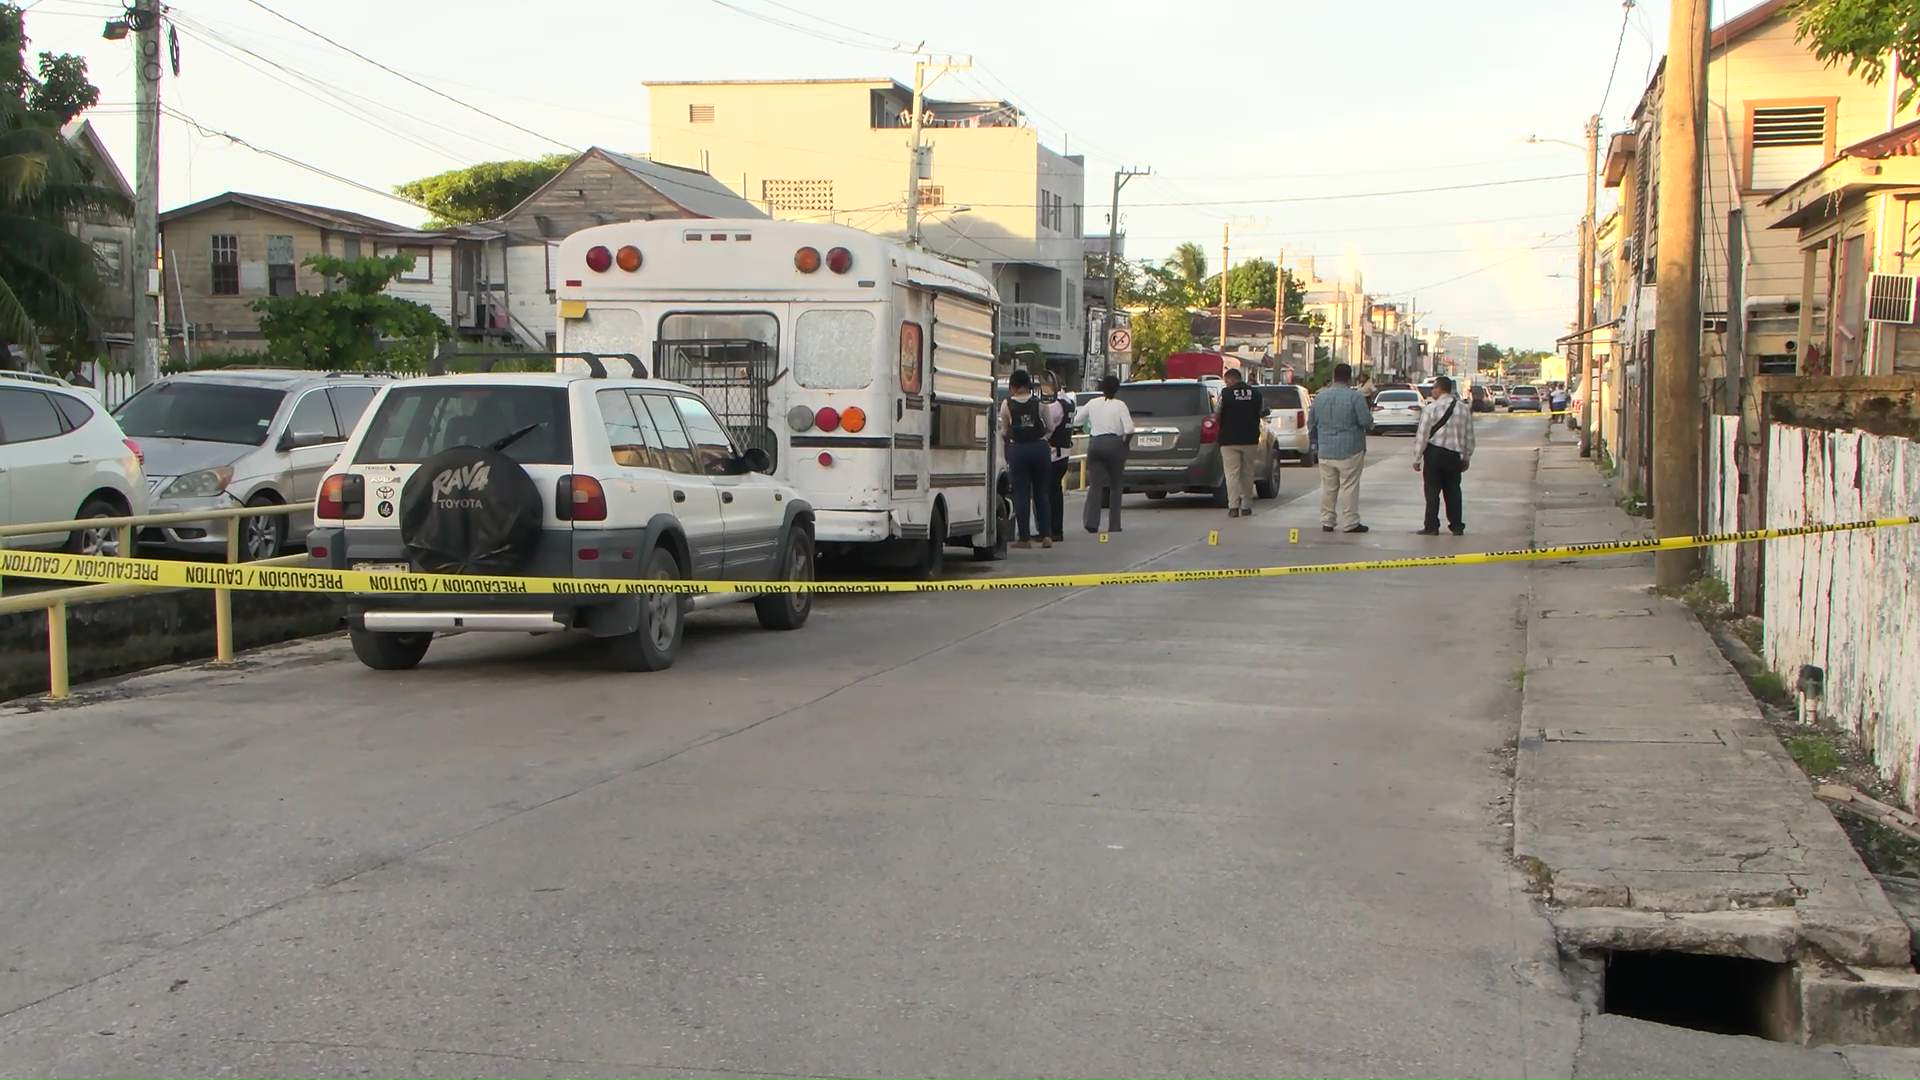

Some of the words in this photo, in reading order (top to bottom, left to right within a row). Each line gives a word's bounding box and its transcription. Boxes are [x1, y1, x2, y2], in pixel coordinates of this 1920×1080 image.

[432, 460, 491, 504] RAV4
[438, 498, 483, 510] TOYOTA
[2, 554, 60, 574] CAUTION
[75, 559, 159, 581] PRECAUCIÓN
[185, 565, 244, 585] CAUTION
[259, 569, 344, 589] PRECAUCIÓN
[369, 575, 428, 591] CAUTION
